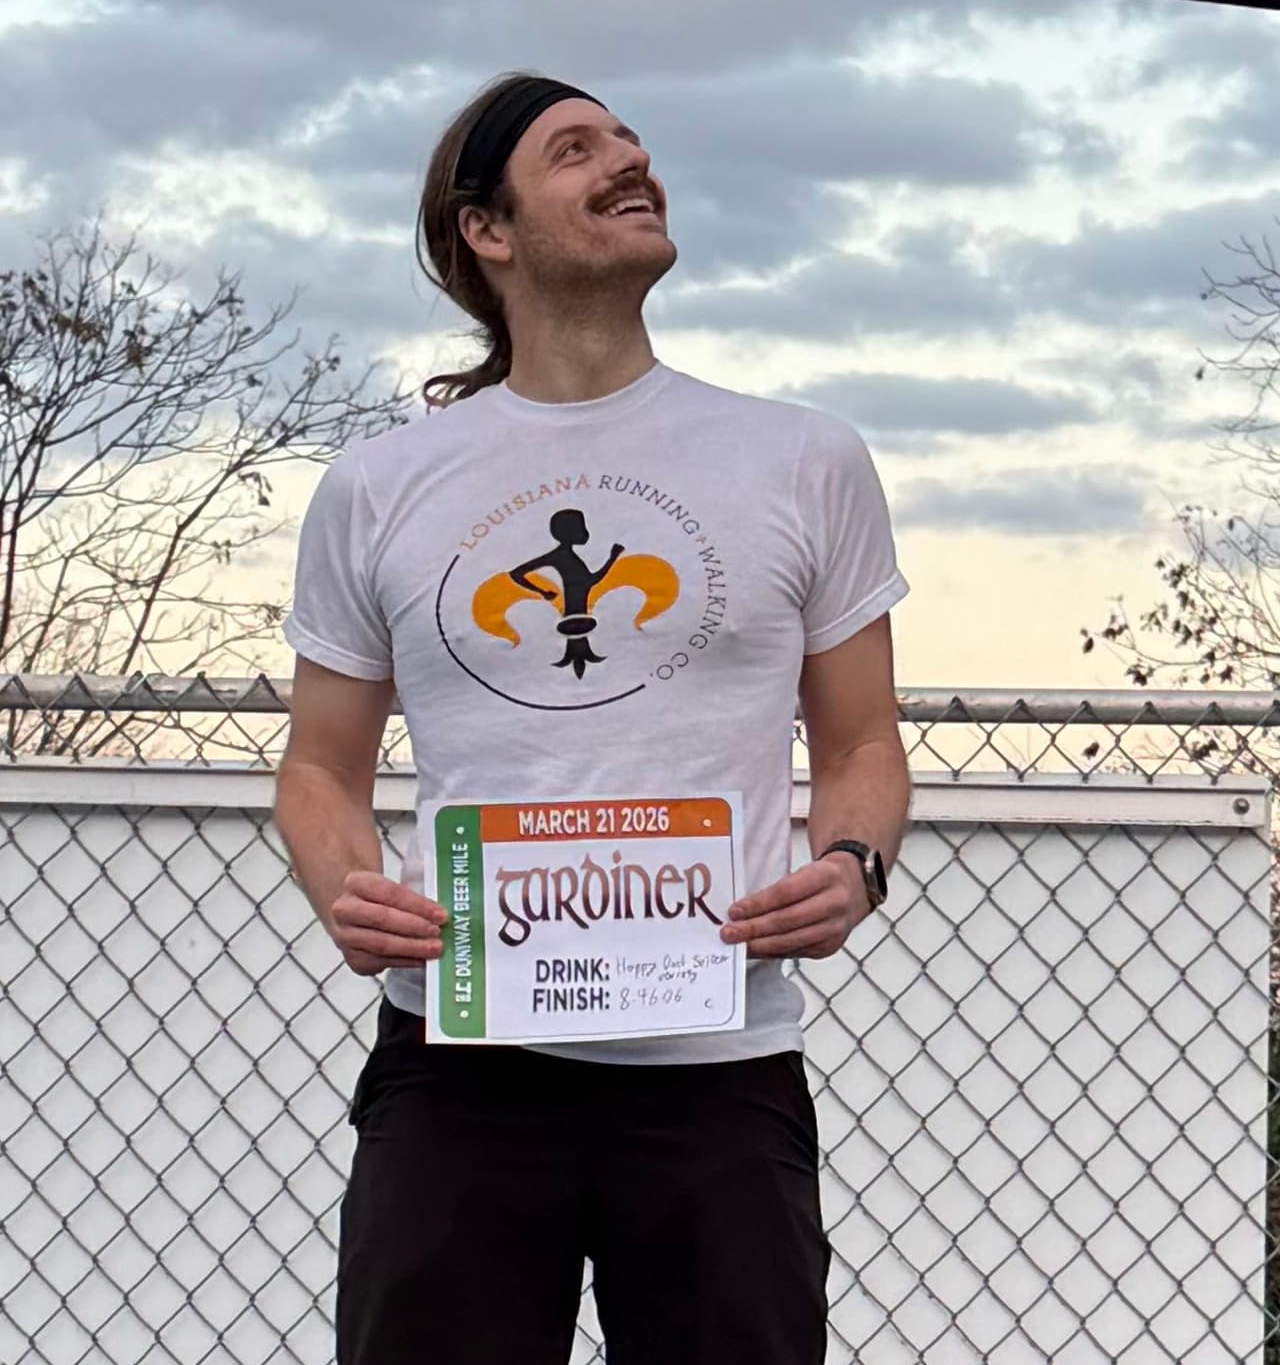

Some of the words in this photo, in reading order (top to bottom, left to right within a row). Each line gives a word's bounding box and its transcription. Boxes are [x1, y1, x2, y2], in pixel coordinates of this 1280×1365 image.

[460, 473, 590, 550] LOUISIANA
[598, 474, 700, 535] RUNNING
[688, 546, 726, 650] WALKING
[649, 652, 689, 680] CO.
[518, 808, 591, 835] MARCH
[596, 807, 616, 834] 21
[621, 806, 670, 833] 2026
[452, 842, 469, 875] MILE
[453, 877, 470, 912] BEER
[453, 915, 471, 977] DUNIWAY
[535, 957, 610, 984] DRINK:
[532, 987, 610, 1015] FINISH:
